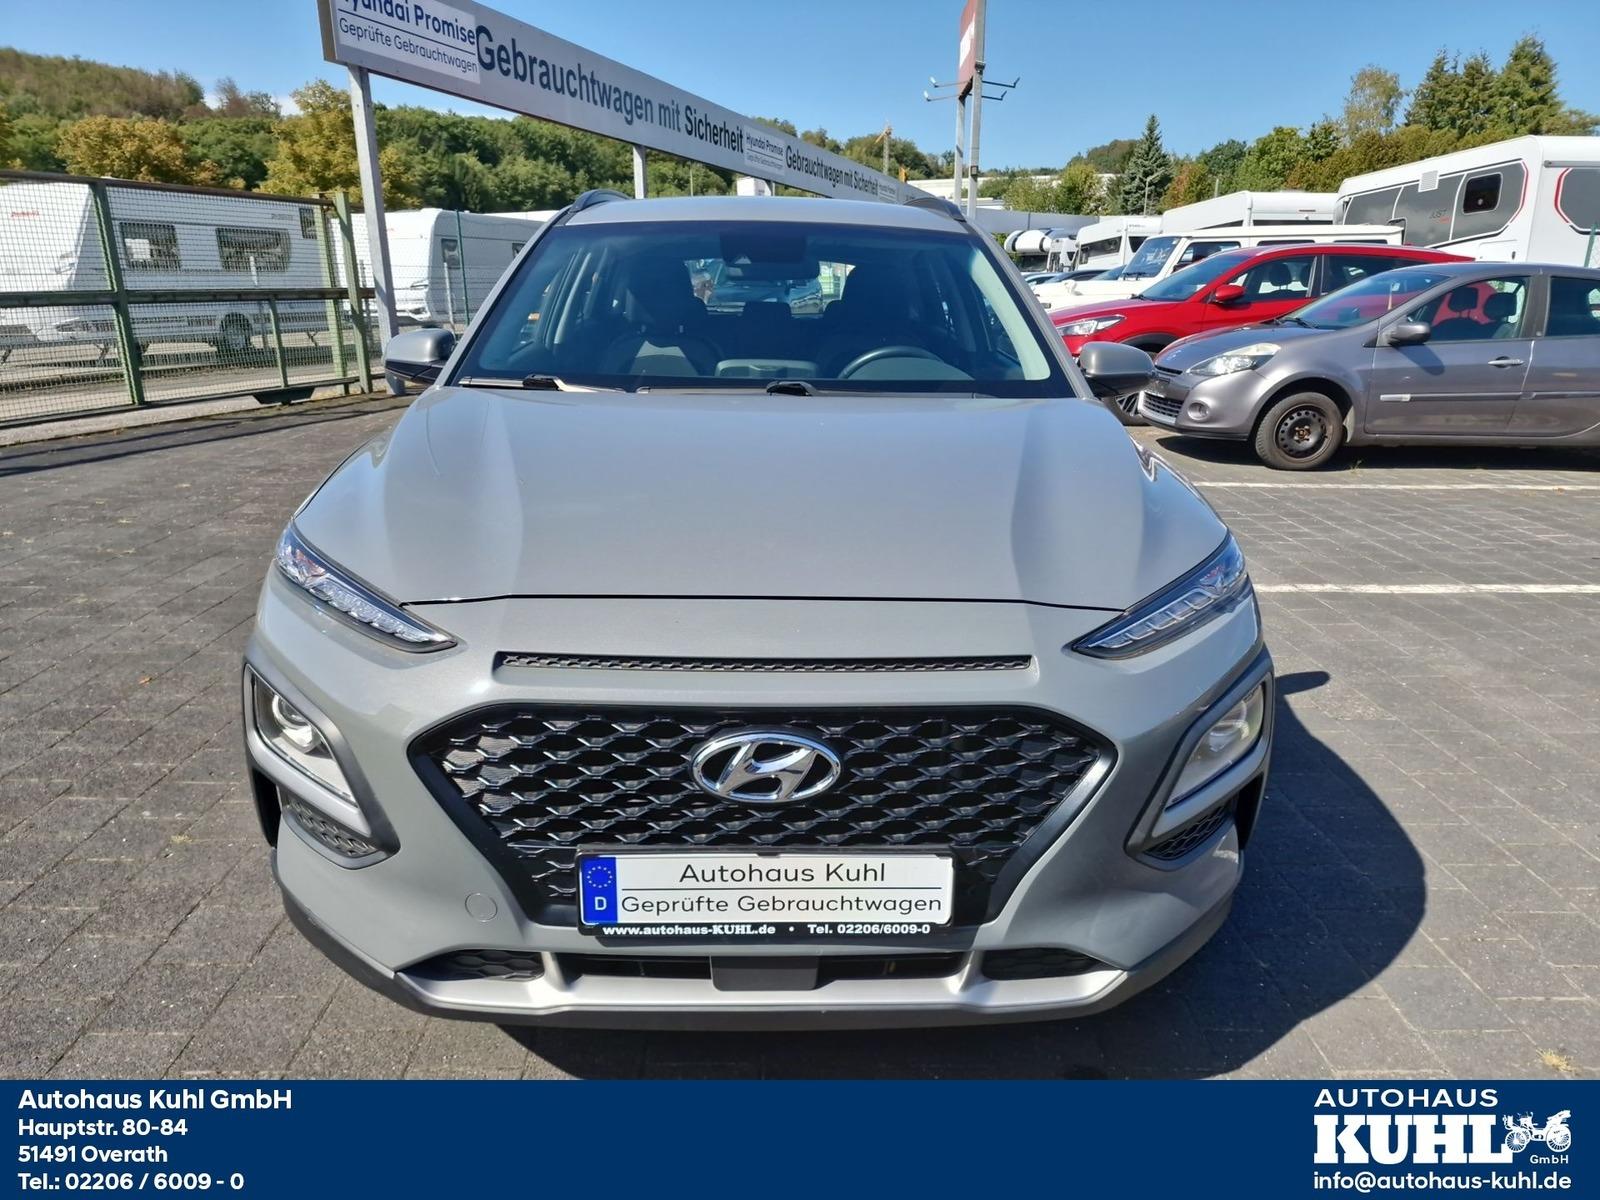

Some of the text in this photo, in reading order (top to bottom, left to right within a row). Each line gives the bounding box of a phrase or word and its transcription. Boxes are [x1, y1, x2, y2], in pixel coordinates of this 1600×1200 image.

[345, 0, 476, 45] yundai Promise
[339, 17, 478, 73] Geprüfte Gebrauchtwagen
[476, 25, 744, 153] Gebrauchtwagen mit Sicherheit
[785, 145, 843, 187] Gebrauchtwagen
[843, 169, 853, 189] mit
[853, 170, 878, 196] Sicherheit
[679, 862, 885, 883] Autohaus Kuhl
[594, 896, 607, 911] D
[621, 895, 942, 916] Geprüfte Gebrauchtwagen
[602, 923, 931, 936] www.autohaus-KUHL.de Tel. 02206/6009-0
